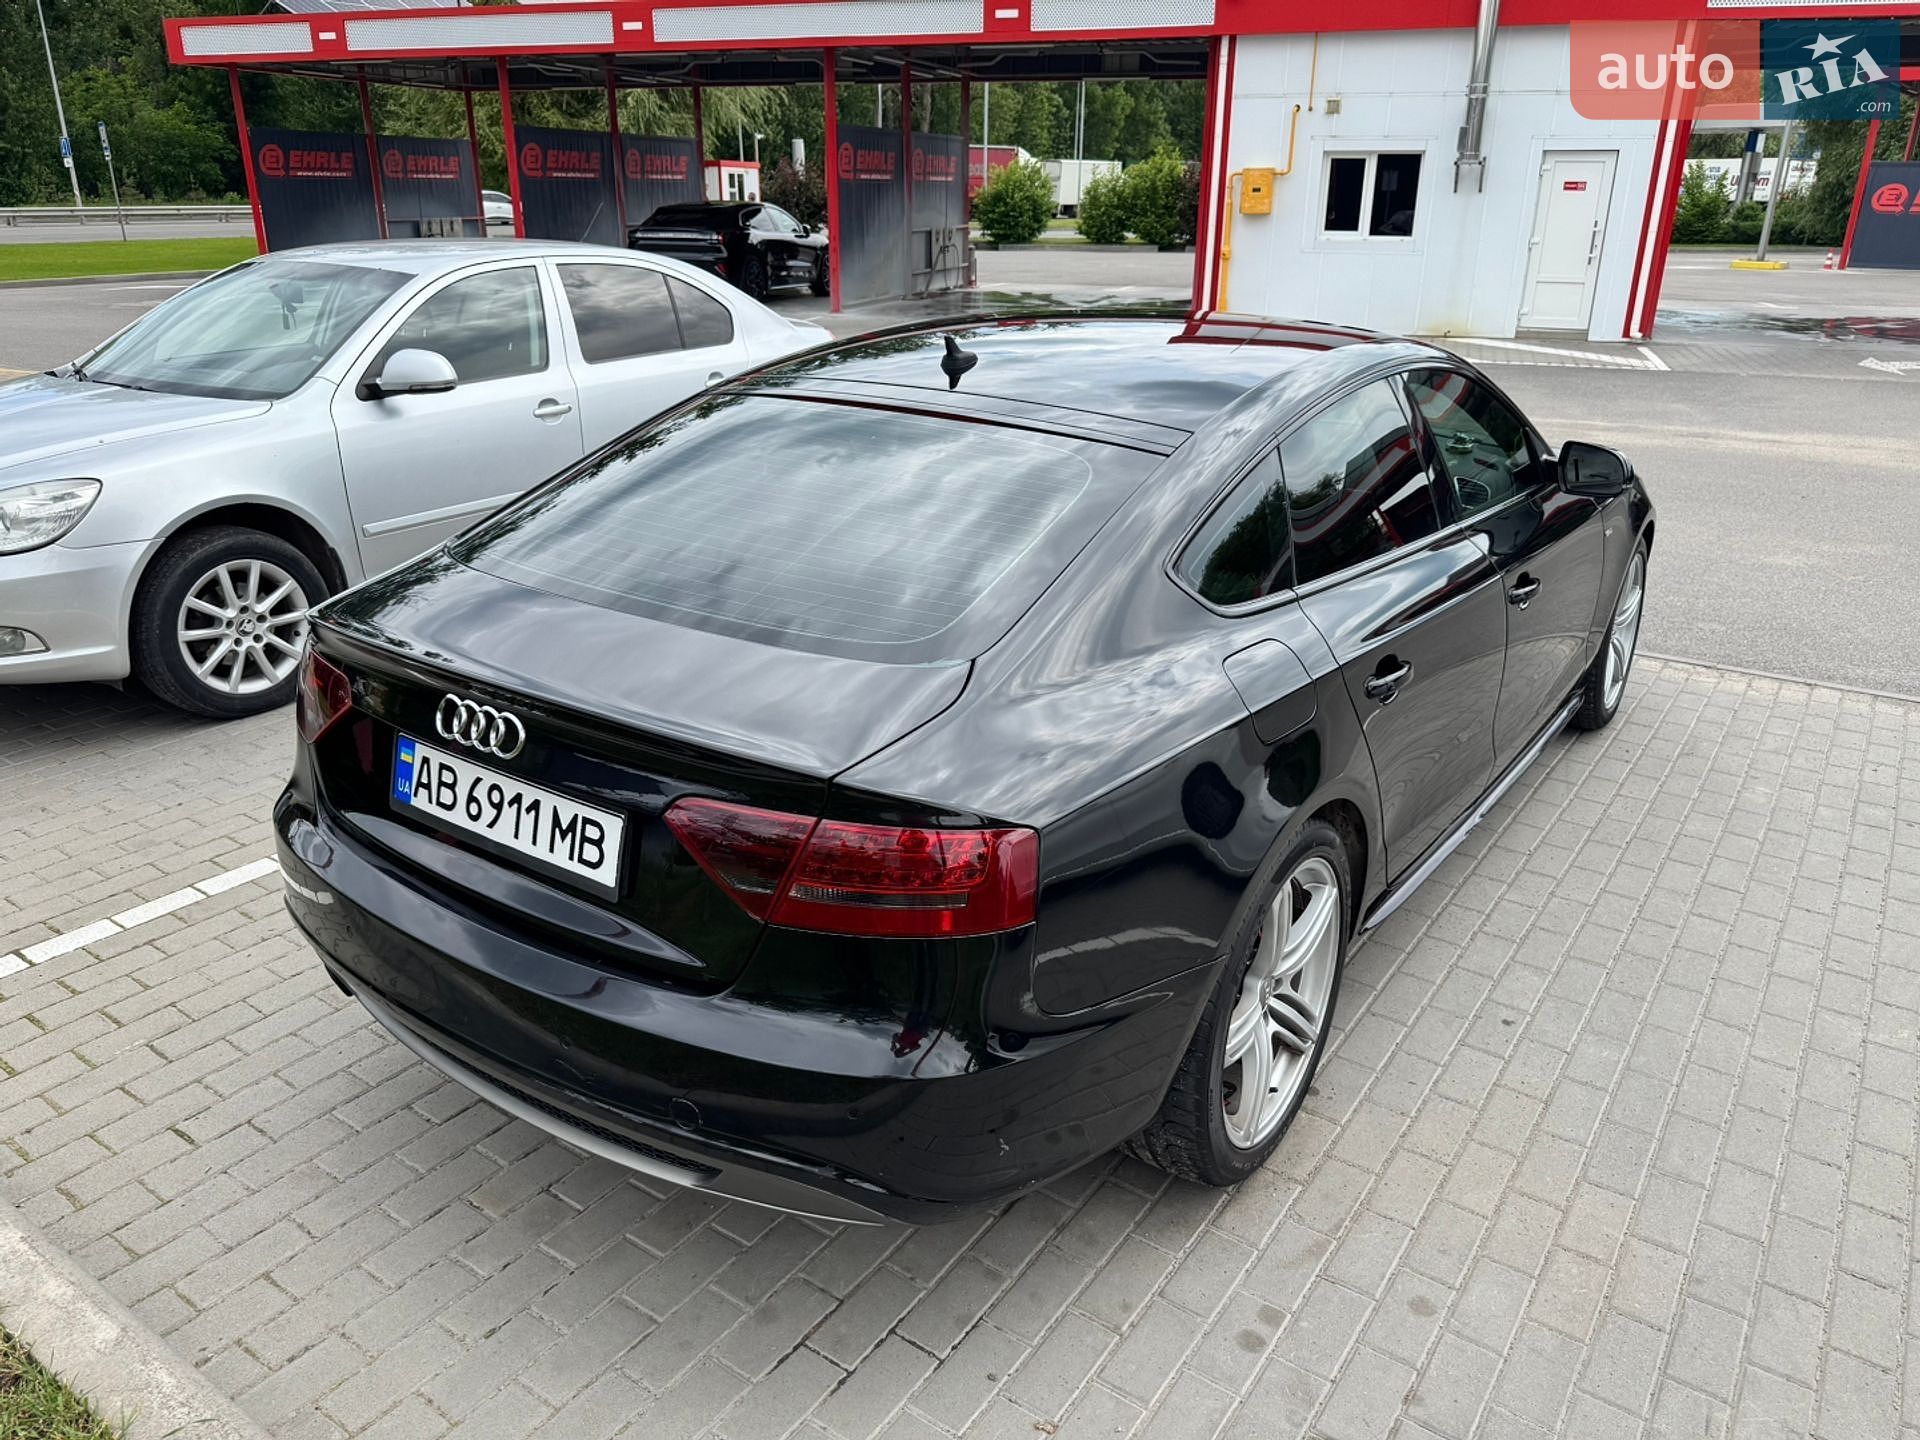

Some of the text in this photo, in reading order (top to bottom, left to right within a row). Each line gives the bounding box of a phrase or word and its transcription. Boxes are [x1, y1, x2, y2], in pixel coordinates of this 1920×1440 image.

[288, 150, 354, 169] EHRLE
[547, 150, 600, 169] EHRLE
[398, 777, 411, 795] UA
[413, 755, 605, 870] AB 6911 MB
